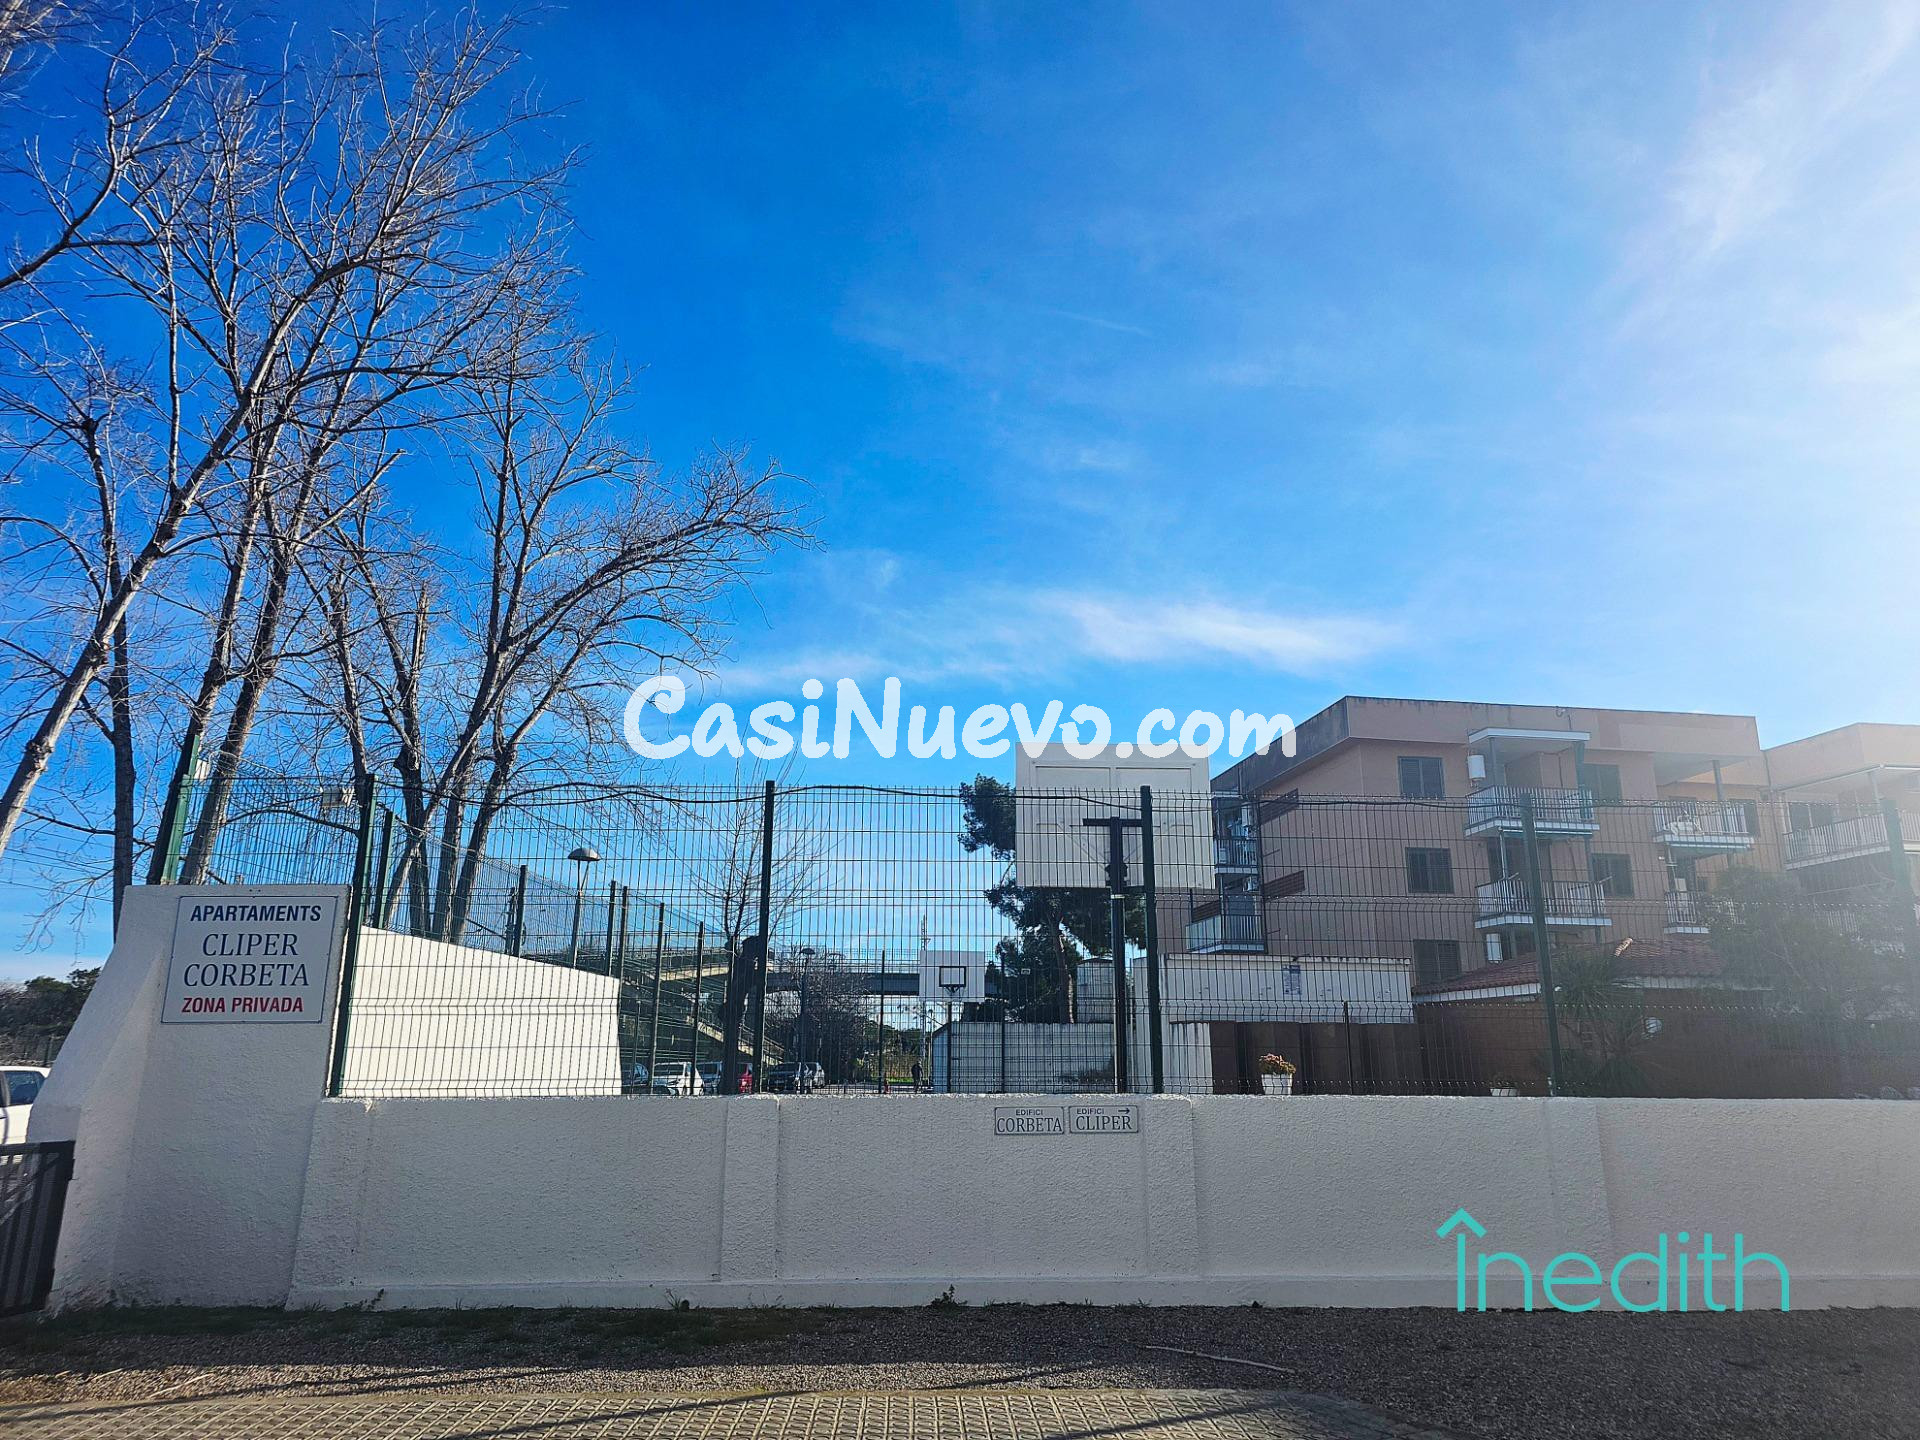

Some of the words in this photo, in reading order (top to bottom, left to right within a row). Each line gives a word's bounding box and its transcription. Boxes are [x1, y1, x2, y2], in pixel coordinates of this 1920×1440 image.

[190, 905, 322, 922] APARTAMENTS
[202, 933, 299, 957] CLIPER
[183, 963, 310, 987] CORBETA
[181, 997, 226, 1013] ZONA
[231, 997, 304, 1013] PRIVADA
[1076, 1107, 1105, 1115] EDIFICI
[997, 1117, 1062, 1132] CORBETA
[1075, 1116, 1132, 1130] CLIPER
